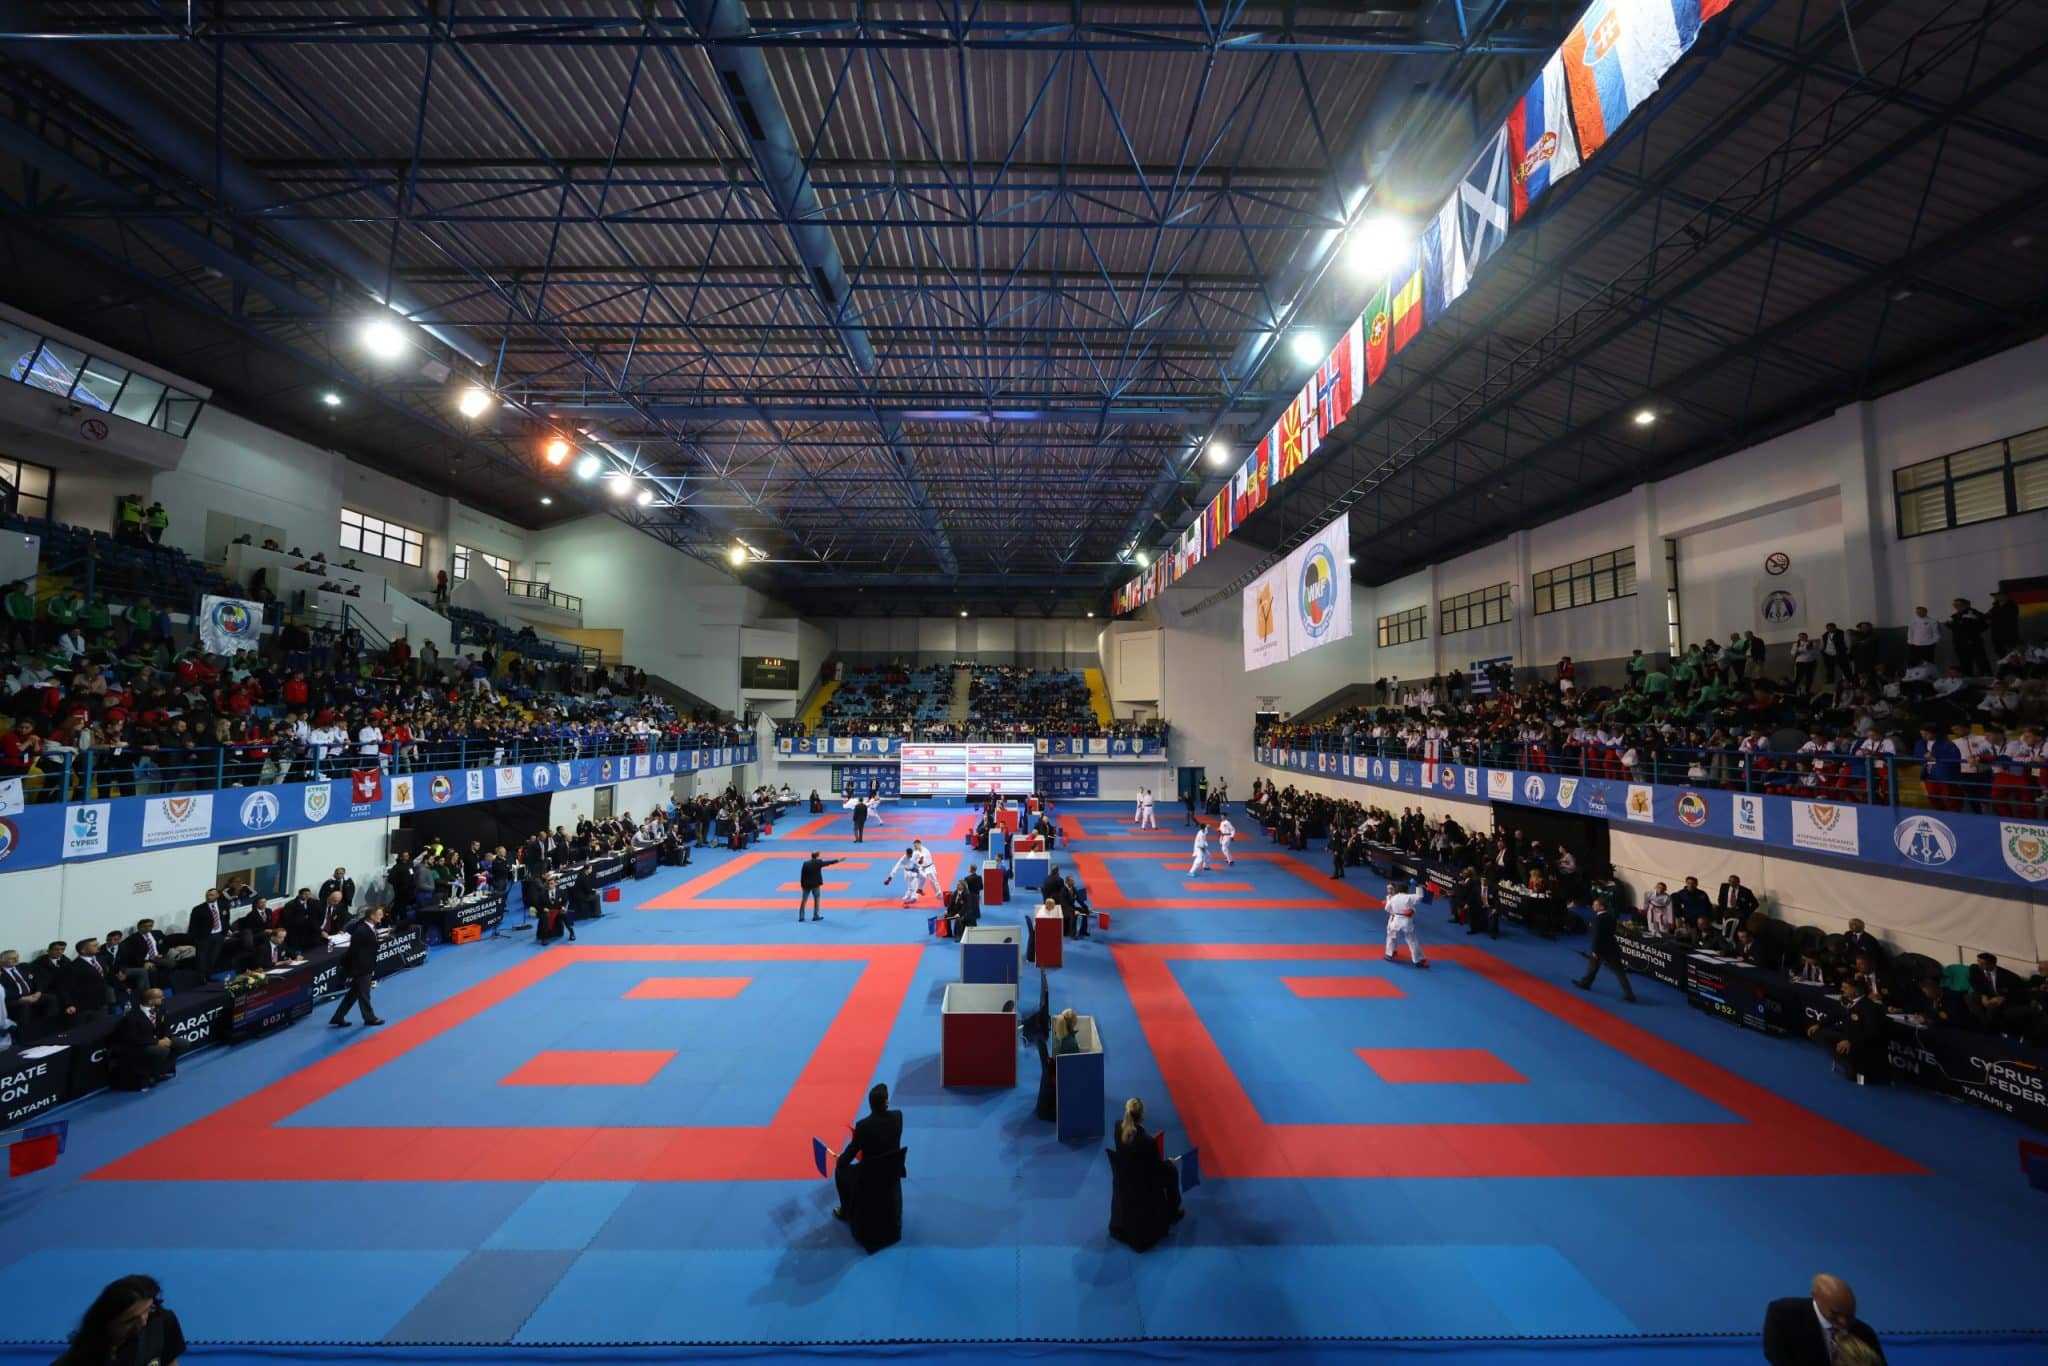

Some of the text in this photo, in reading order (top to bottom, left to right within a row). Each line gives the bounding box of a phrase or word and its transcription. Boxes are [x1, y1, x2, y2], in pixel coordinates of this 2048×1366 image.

[70, 839, 99, 848] CYPRUS
[457, 905, 481, 918] CYPRUS
[463, 907, 497, 924] FEDERATION
[388, 932, 416, 948] KARATE
[1640, 943, 1672, 962] KARATE
[1888, 1039, 1937, 1065] RATE
[1, 1063, 47, 1089] RATE
[1970, 1056, 2043, 1091] CYPRUS
[1962, 1085, 2003, 1108] TATAMI
[8, 1097, 50, 1120] TATAMI
